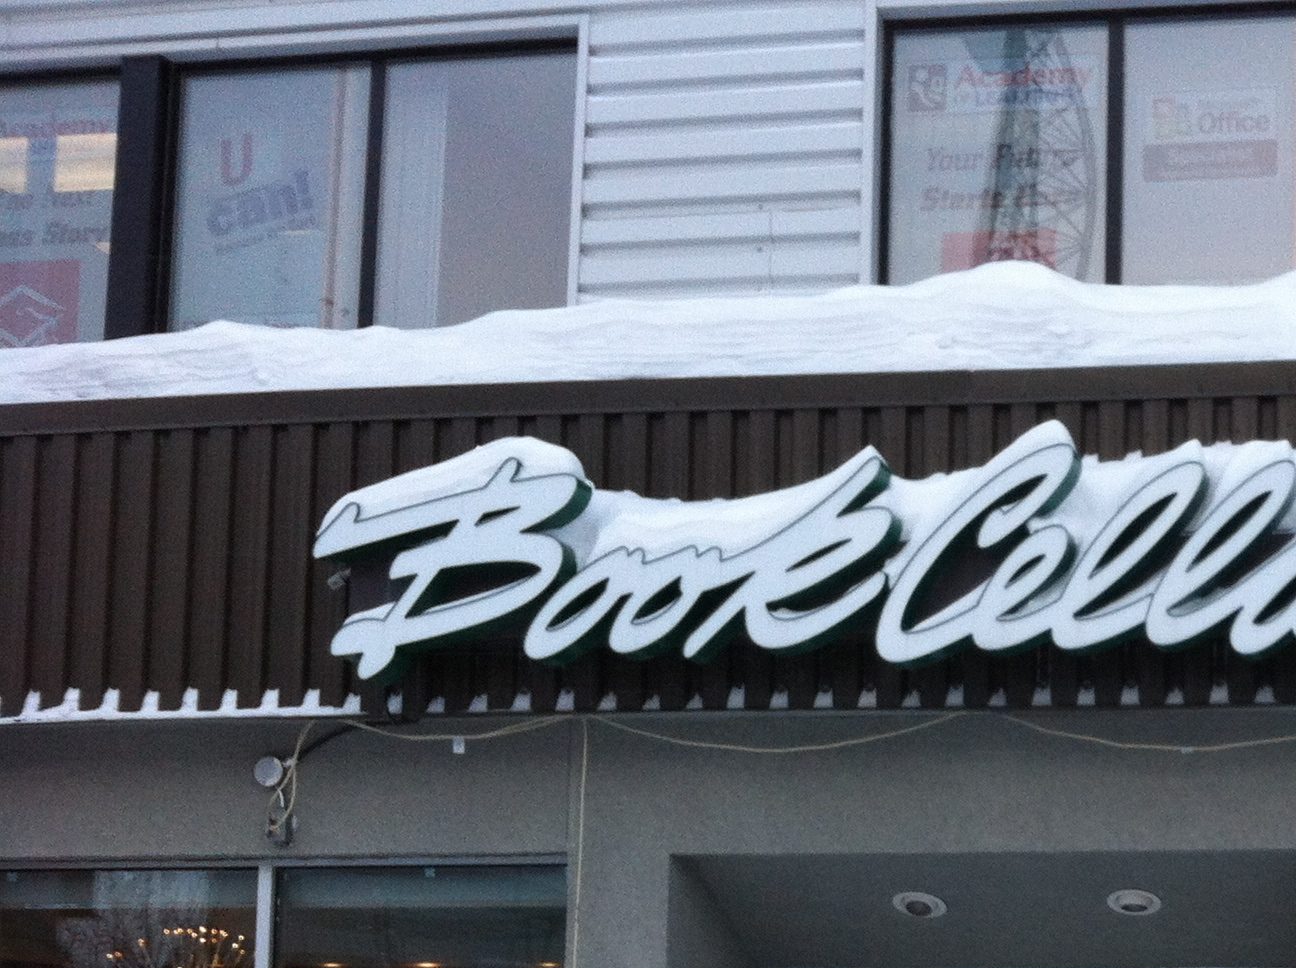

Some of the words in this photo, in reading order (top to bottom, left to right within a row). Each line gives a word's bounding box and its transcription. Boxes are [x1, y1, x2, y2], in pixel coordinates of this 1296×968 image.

[1197, 110, 1271, 134] Office
[220, 132, 254, 186] U
[312, 444, 902, 680] Book
